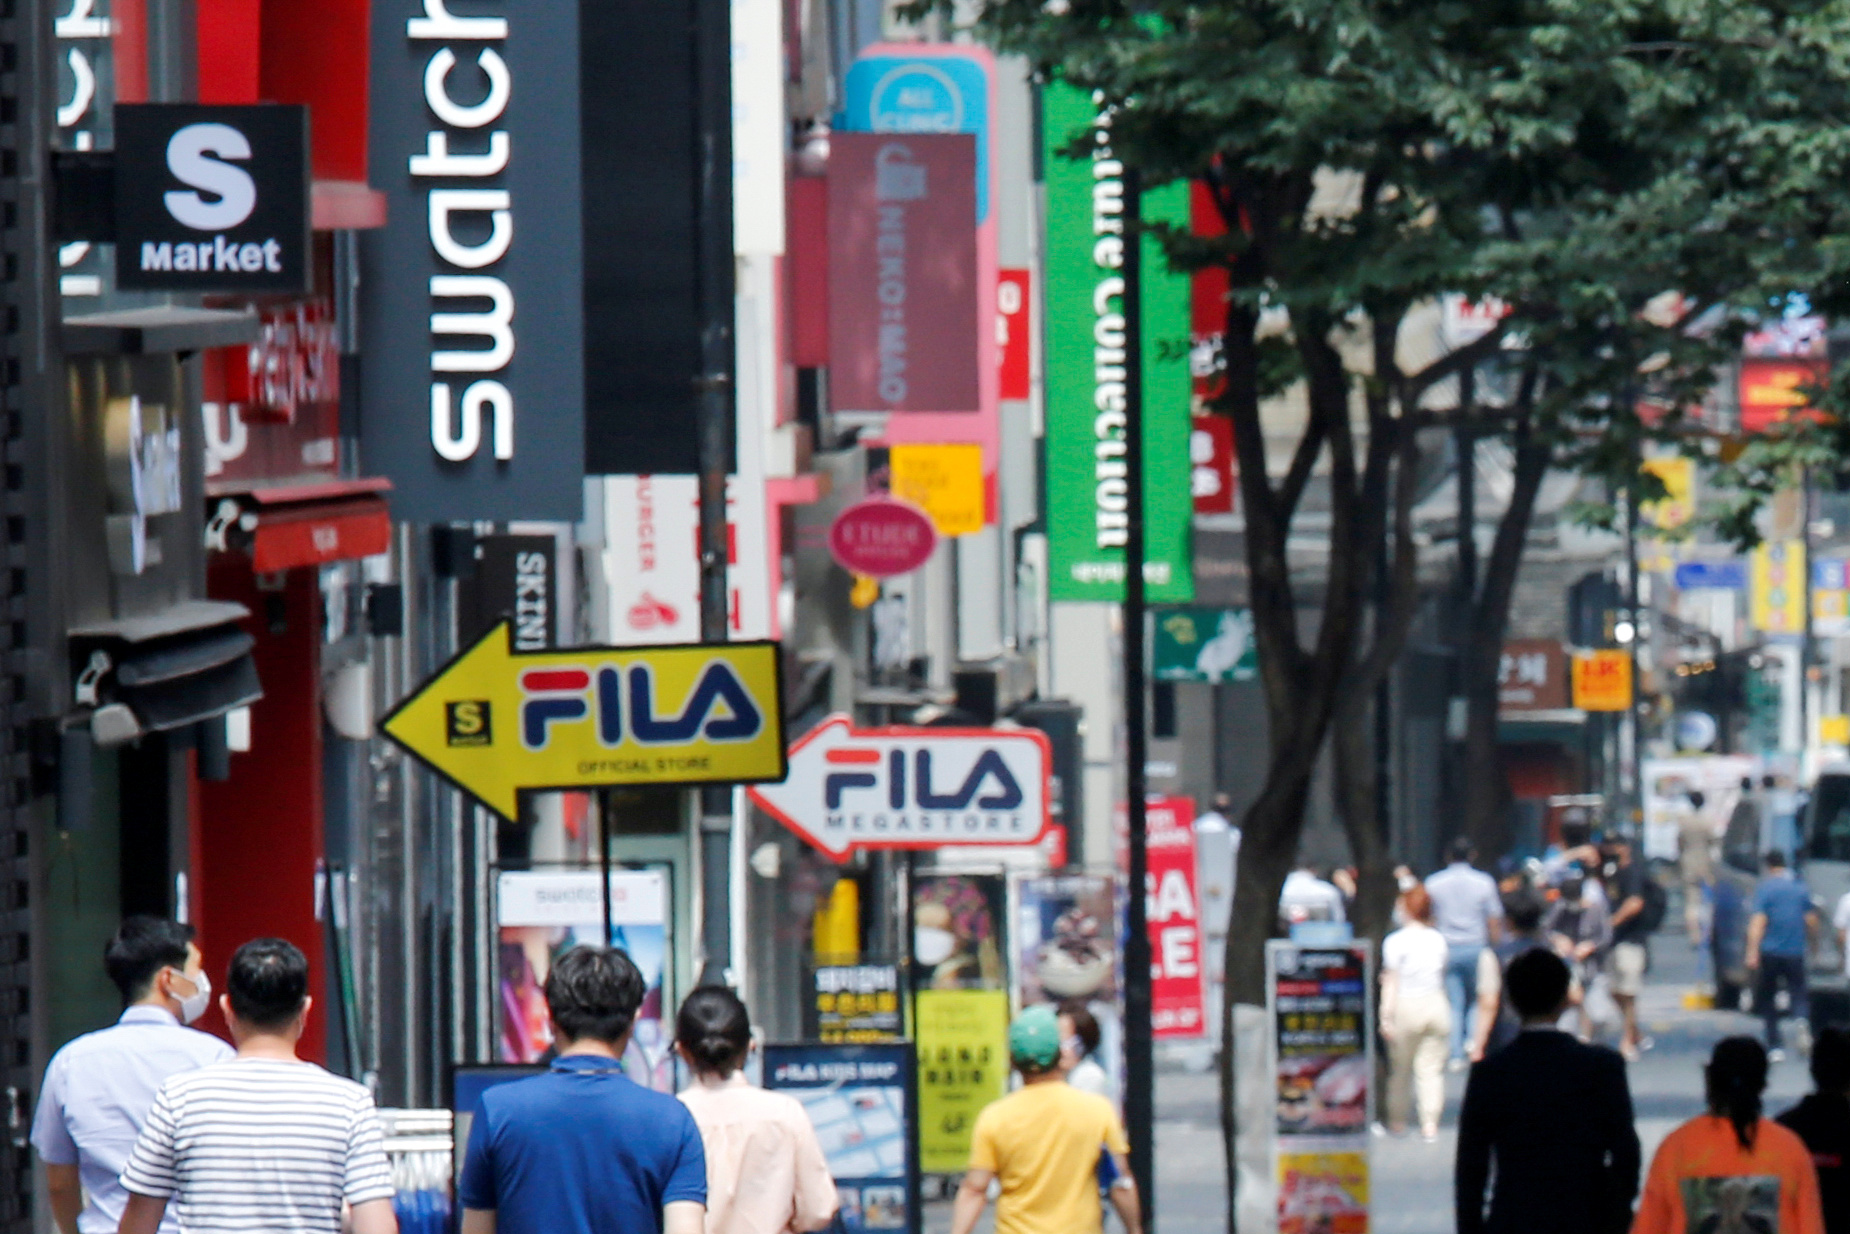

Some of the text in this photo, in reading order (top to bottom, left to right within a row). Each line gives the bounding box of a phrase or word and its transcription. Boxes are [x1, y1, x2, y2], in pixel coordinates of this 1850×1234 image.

[164, 122, 256, 230] S
[141, 236, 281, 272] Market
[407, 0, 516, 462] swatch
[519, 660, 763, 750] FILA
[577, 755, 711, 773] OFFICIAL STORE
[824, 749, 1024, 810] FILA
[825, 812, 1024, 832] MEGASTORE
